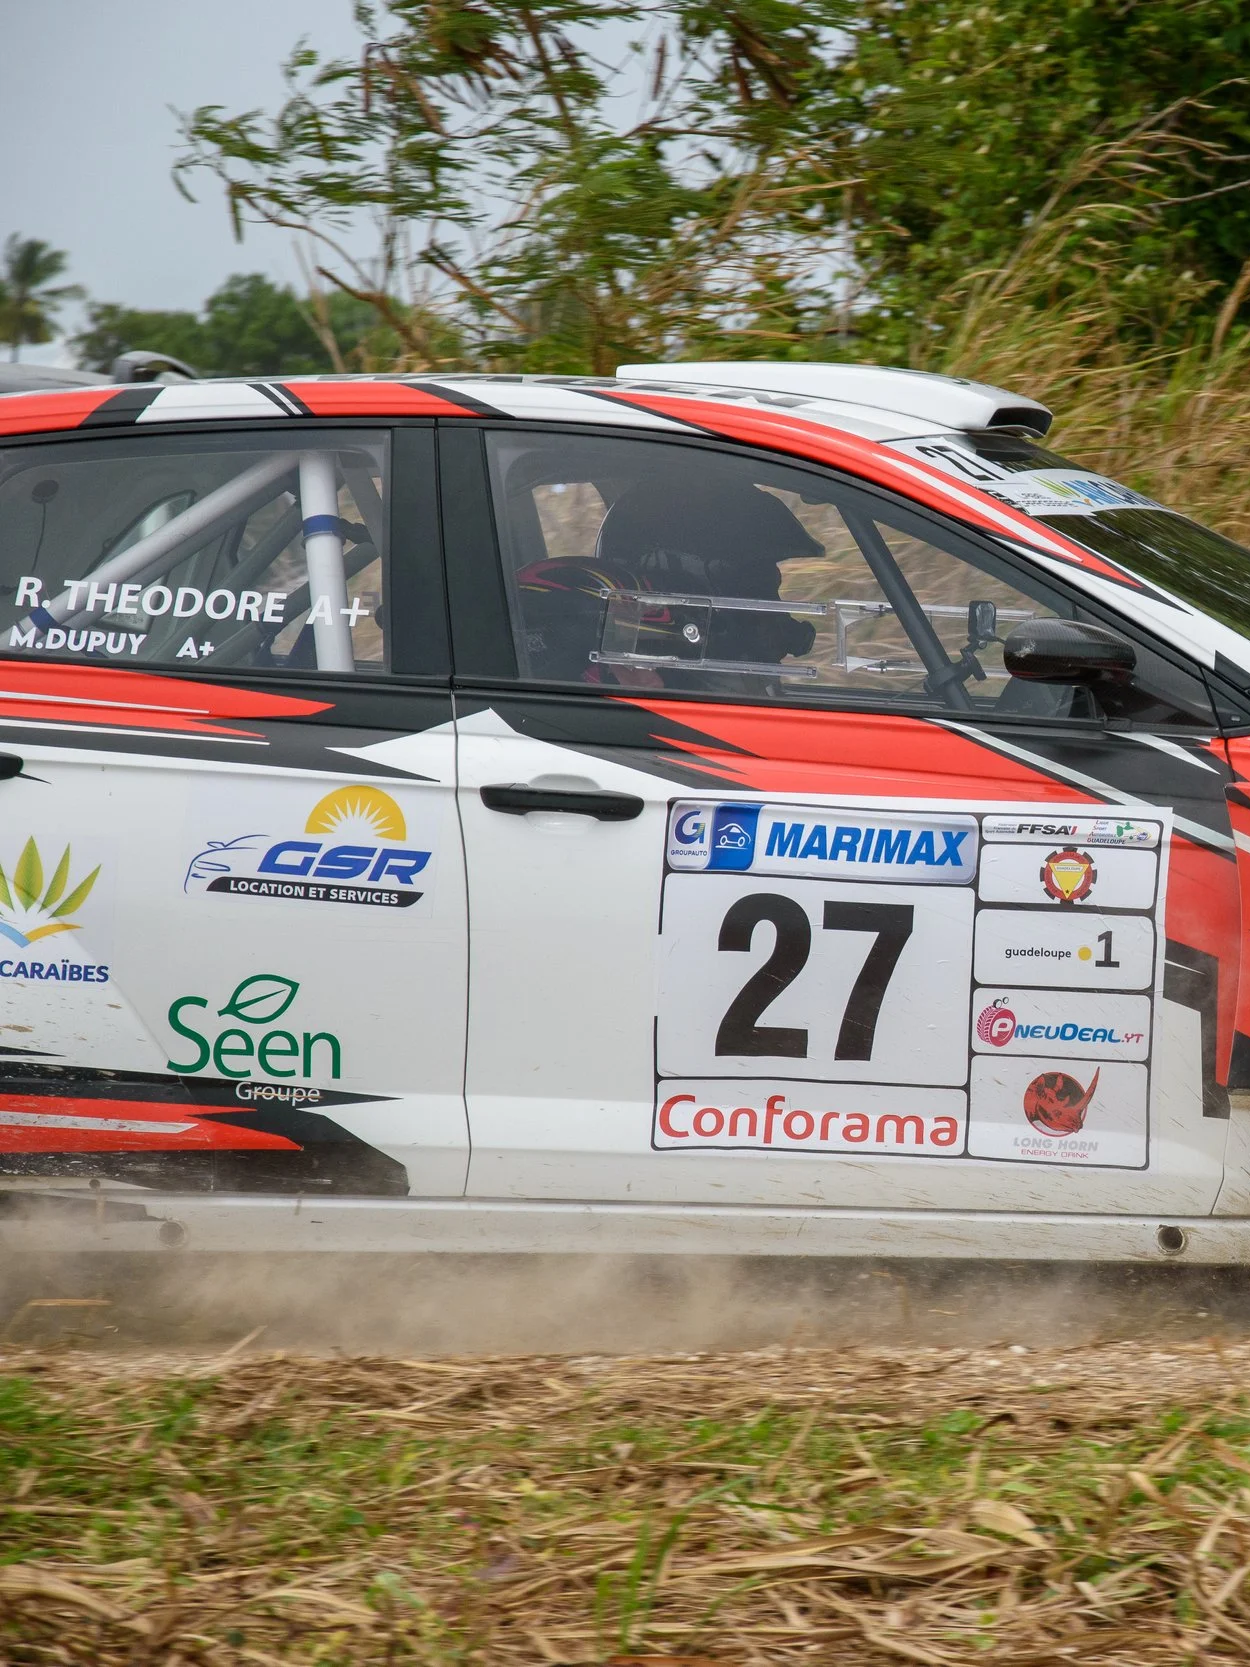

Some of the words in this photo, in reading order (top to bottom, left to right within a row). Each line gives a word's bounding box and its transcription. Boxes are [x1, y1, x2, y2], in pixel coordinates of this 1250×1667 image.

[915, 445, 1005, 482] 27
[15, 576, 50, 609] R.
[63, 580, 288, 624] THEODORE
[9, 625, 147, 655] M.DUPUY
[175, 637, 215, 660] A+
[765, 822, 969, 866] MARIMAX
[1017, 823, 1072, 836] FFSA
[257, 840, 432, 885] GSR
[670, 849, 708, 857] GROUPAUTO
[230, 880, 305, 898] LOCATION
[308, 886, 325, 899] ET
[329, 888, 399, 905] SERVICES
[1005, 947, 1072, 960] guadeloupe
[1095, 930, 1120, 968] 1
[0, 959, 109, 983] CARAÏBES
[714, 892, 915, 1061] 27
[166, 995, 341, 1080] Seen
[235, 1081, 322, 1106] Groupe
[658, 1094, 958, 1147] Conforama
[1013, 1137, 1053, 1149] LONG
[1057, 1139, 1099, 1152] HORN
[1020, 1148, 1058, 1157] ENERGY
[1060, 1151, 1089, 1159] DRINK
